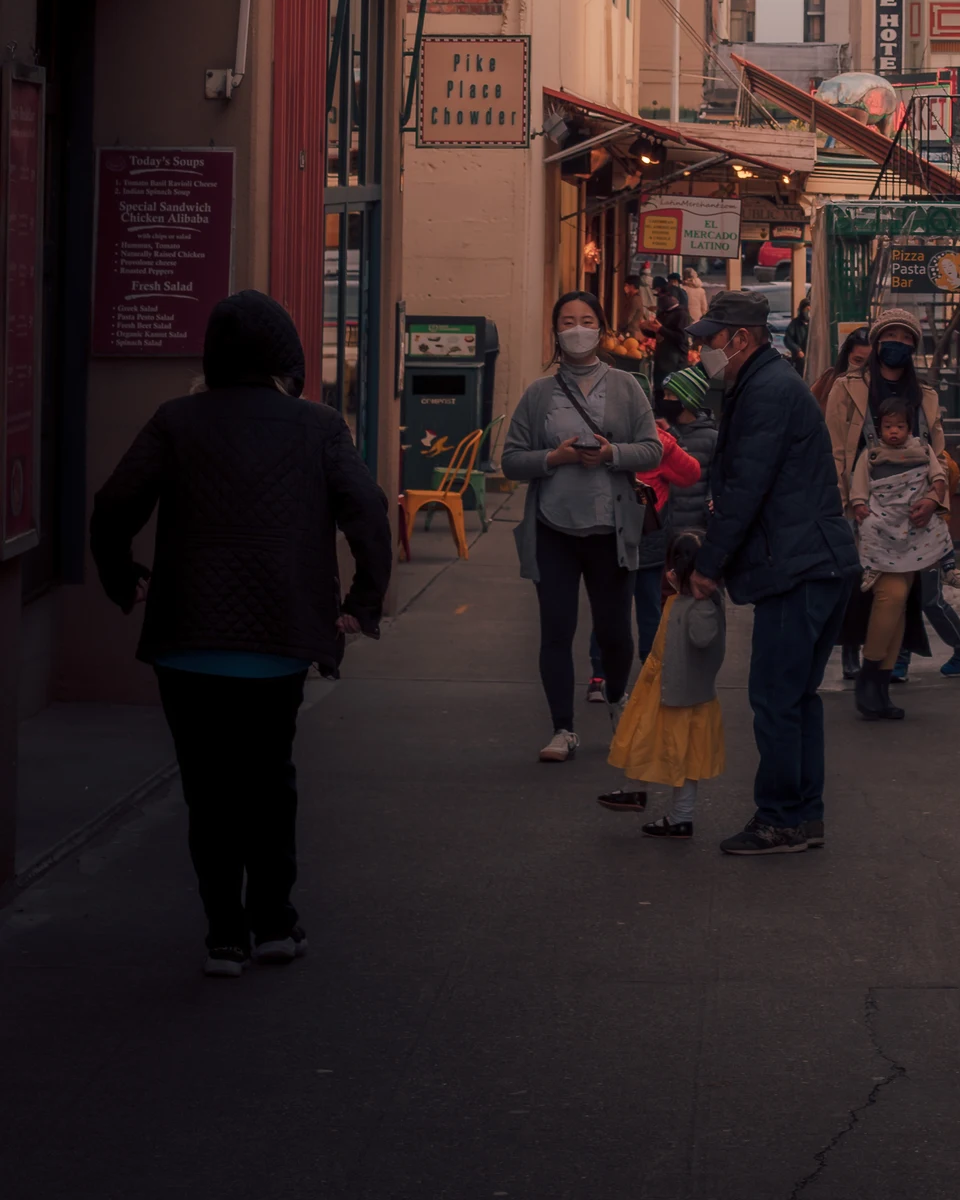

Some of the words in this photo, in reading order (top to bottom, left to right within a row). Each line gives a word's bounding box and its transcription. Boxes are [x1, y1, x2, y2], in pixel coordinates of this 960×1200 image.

[879, 14, 899, 76] HOTE
[453, 53, 496, 72] Pike
[447, 80, 502, 99] Place
[431, 106, 517, 126] Chowder
[128, 155, 171, 168] Today's
[172, 156, 205, 169] Soups
[123, 179, 149, 187] Tomato
[168, 180, 192, 188] Ravioli
[146, 188, 172, 197] Spinach
[173, 189, 191, 197] Soup
[119, 201, 157, 214] Special
[159, 202, 211, 213] Sandwich
[120, 212, 165, 223] Chicken
[167, 213, 210, 224] Alibaba
[704, 220, 718, 229] EL
[684, 229, 738, 241] MERCADO
[154, 241, 181, 249] Tomato
[690, 241, 730, 251] LATINO
[120, 250, 152, 259] Naturally
[153, 250, 177, 258] Raised
[177, 251, 206, 259] Chicken
[892, 249, 925, 263] Pizza
[155, 259, 177, 267] cheese
[119, 267, 147, 275] Roasted
[148, 268, 174, 276] Peppers
[892, 263, 926, 275] Pasta
[131, 280, 162, 292] Fresh
[163, 281, 193, 292] Salad
[892, 277, 913, 288] Bar
[117, 304, 139, 312] Greek
[139, 304, 158, 312] Salad
[117, 313, 135, 321] Pasta
[136, 313, 155, 321] Pesto
[156, 313, 175, 321] Salad
[115, 339, 142, 348] Spinach
[143, 339, 163, 347] Salad
